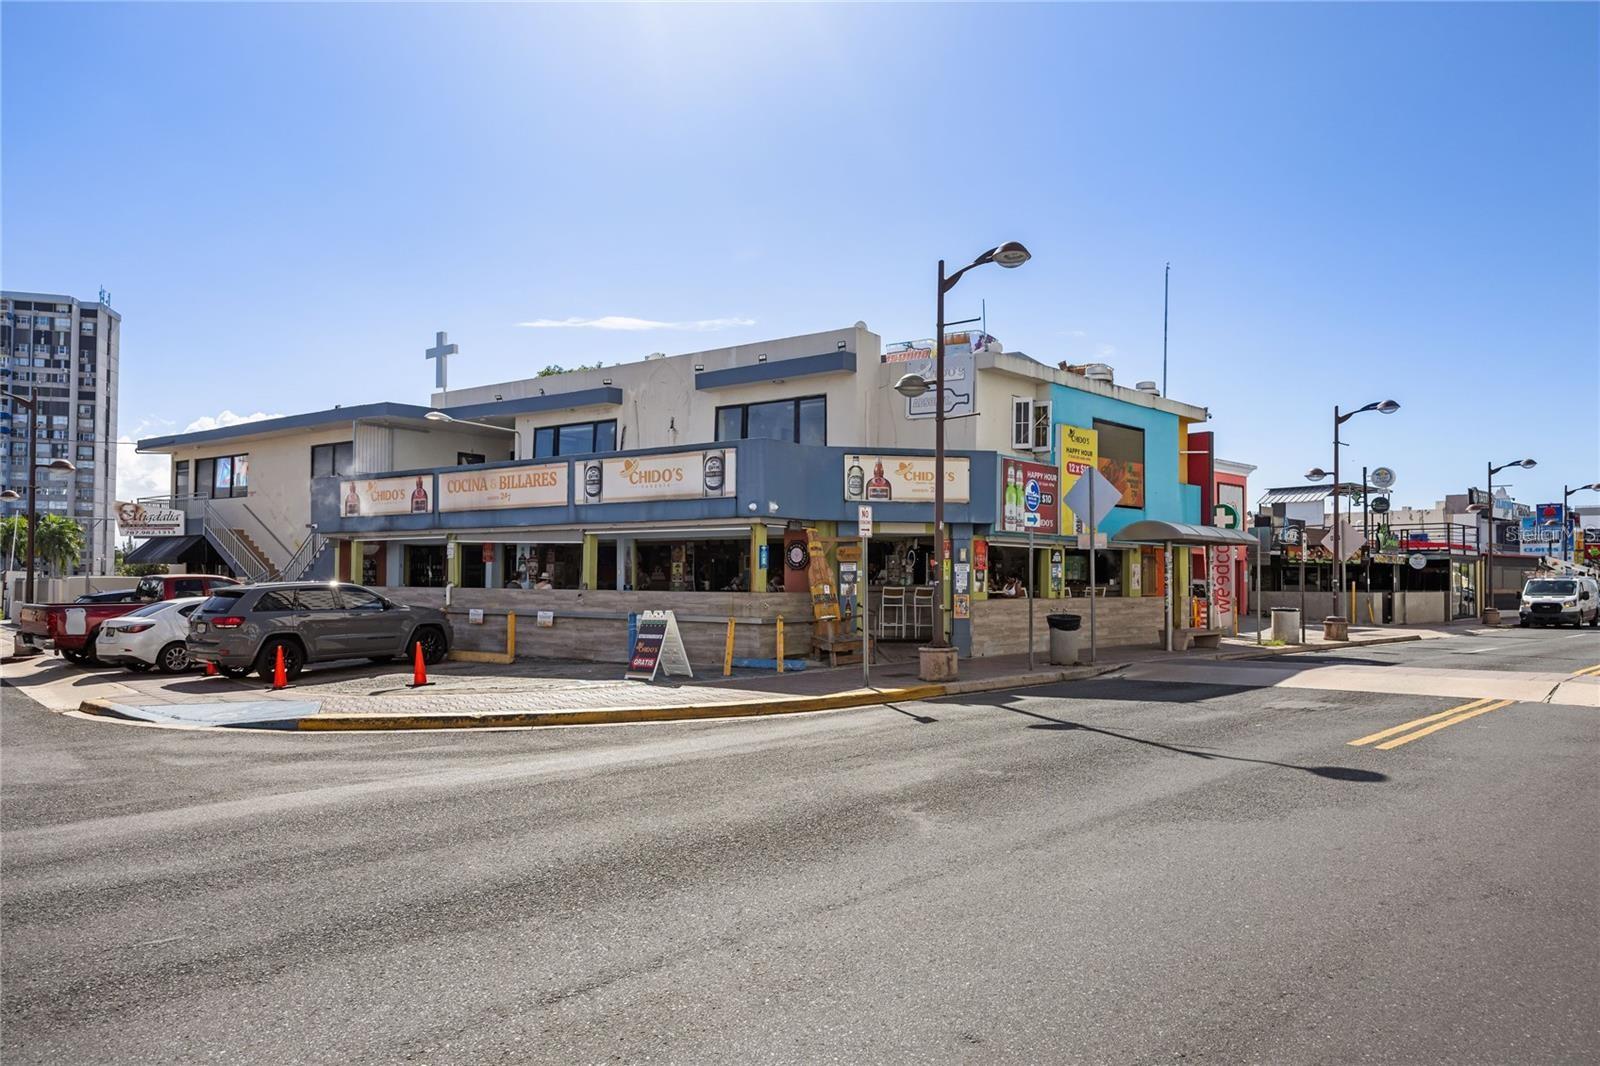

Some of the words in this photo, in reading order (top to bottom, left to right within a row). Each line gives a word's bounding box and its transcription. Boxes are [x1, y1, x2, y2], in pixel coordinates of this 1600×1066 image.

[1066, 447, 1080, 456] HAPPY
[1081, 449, 1093, 457] HOUR
[628, 466, 684, 485] CHIDO'S
[903, 471, 956, 482] CHID'S
[1027, 471, 1043, 480] HAPPY
[1043, 472, 1057, 482] HOUR
[447, 478, 488, 494] COCINA
[499, 471, 557, 490] BILLARES
[371, 487, 406, 502] CHIDO'S
[1041, 494, 1052, 504] $10
[861, 509, 869, 519] NO
[633, 658, 654, 666] GRATIS
